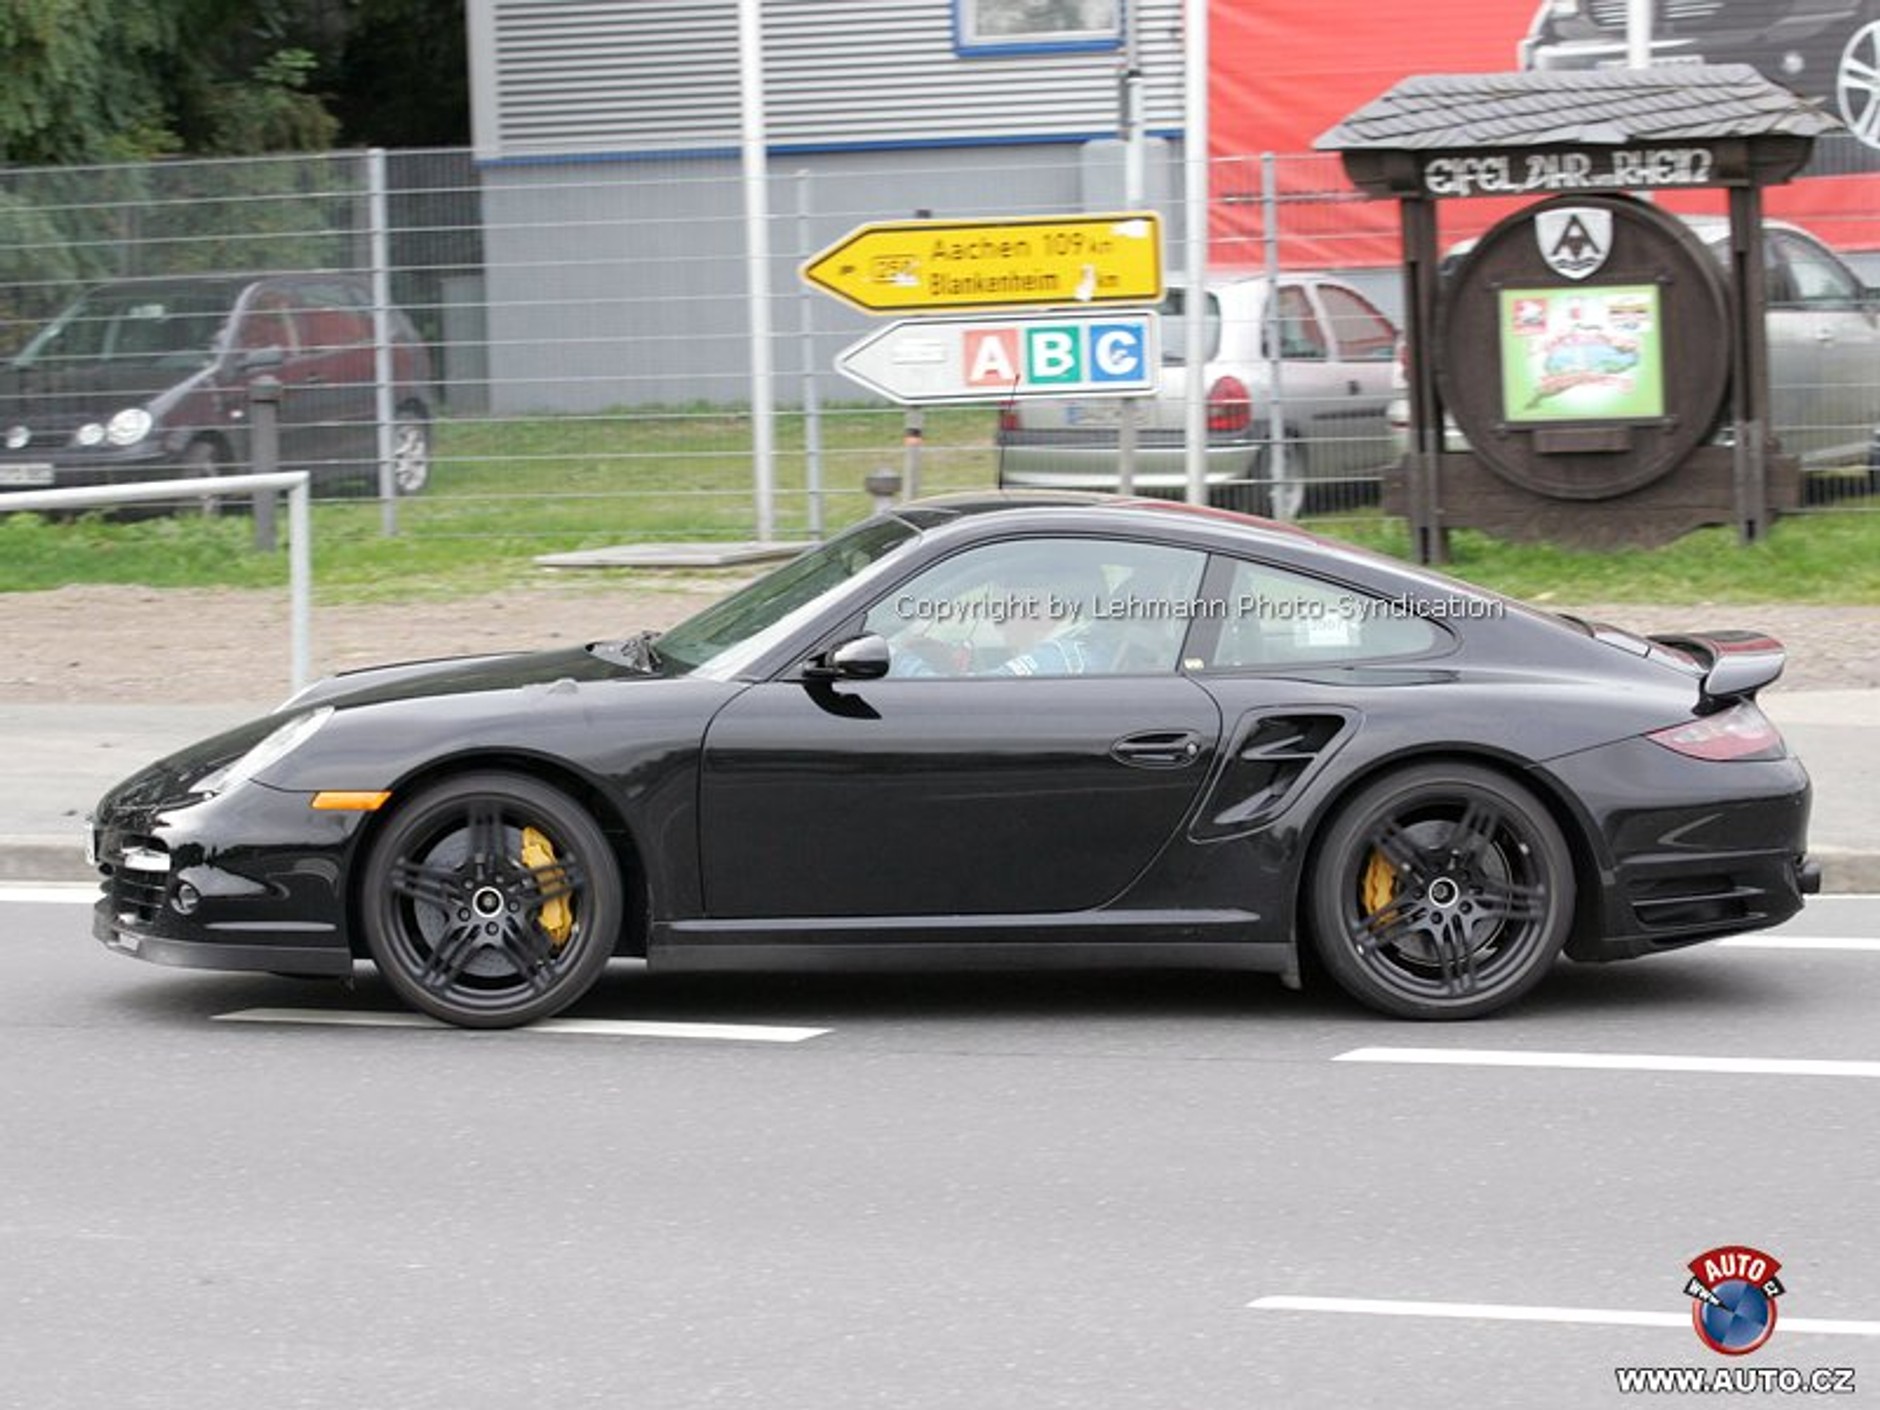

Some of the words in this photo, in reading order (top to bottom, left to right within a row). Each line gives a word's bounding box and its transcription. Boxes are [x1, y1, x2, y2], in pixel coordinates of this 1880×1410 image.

[931, 237, 1032, 260] Aachen
[1042, 232, 1083, 257] 109
[930, 270, 1060, 296] Blankenheim
[968, 335, 1017, 382] A
[1032, 331, 1076, 378] B
[1095, 330, 1139, 376] C
